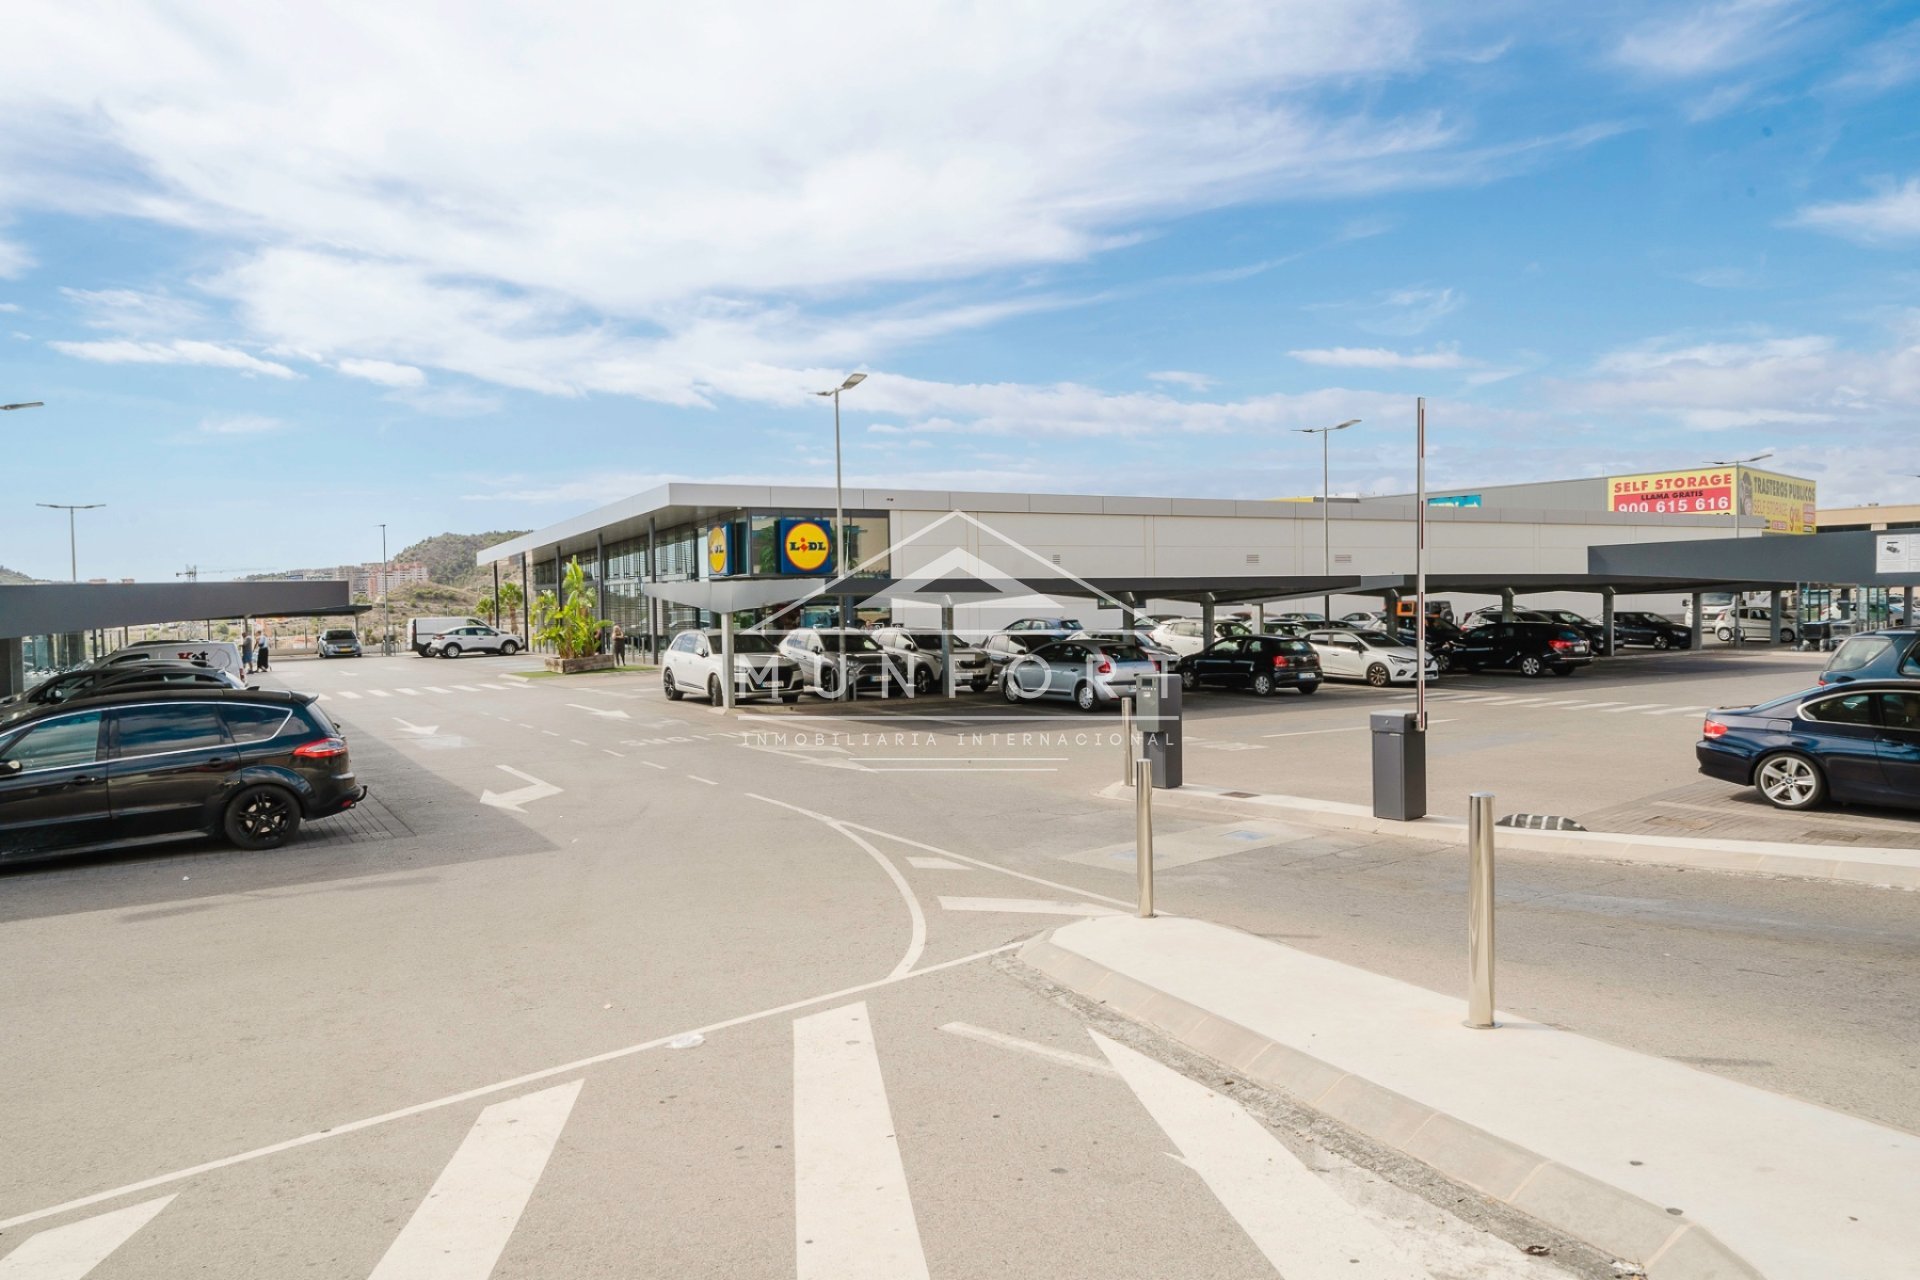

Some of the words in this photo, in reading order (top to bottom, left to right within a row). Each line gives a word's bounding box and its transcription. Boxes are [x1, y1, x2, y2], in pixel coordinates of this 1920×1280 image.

[1614, 480, 1649, 493] SELF
[1655, 473, 1732, 490] STORAGE
[1753, 476, 1788, 498] TRASTEROS
[1641, 491, 1669, 501] LLAMA
[1671, 490, 1703, 499] GRATIS
[1618, 502, 1649, 512] 900
[1655, 499, 1688, 512] 615
[1695, 496, 1729, 511] 616
[789, 537, 827, 553] LIDL
